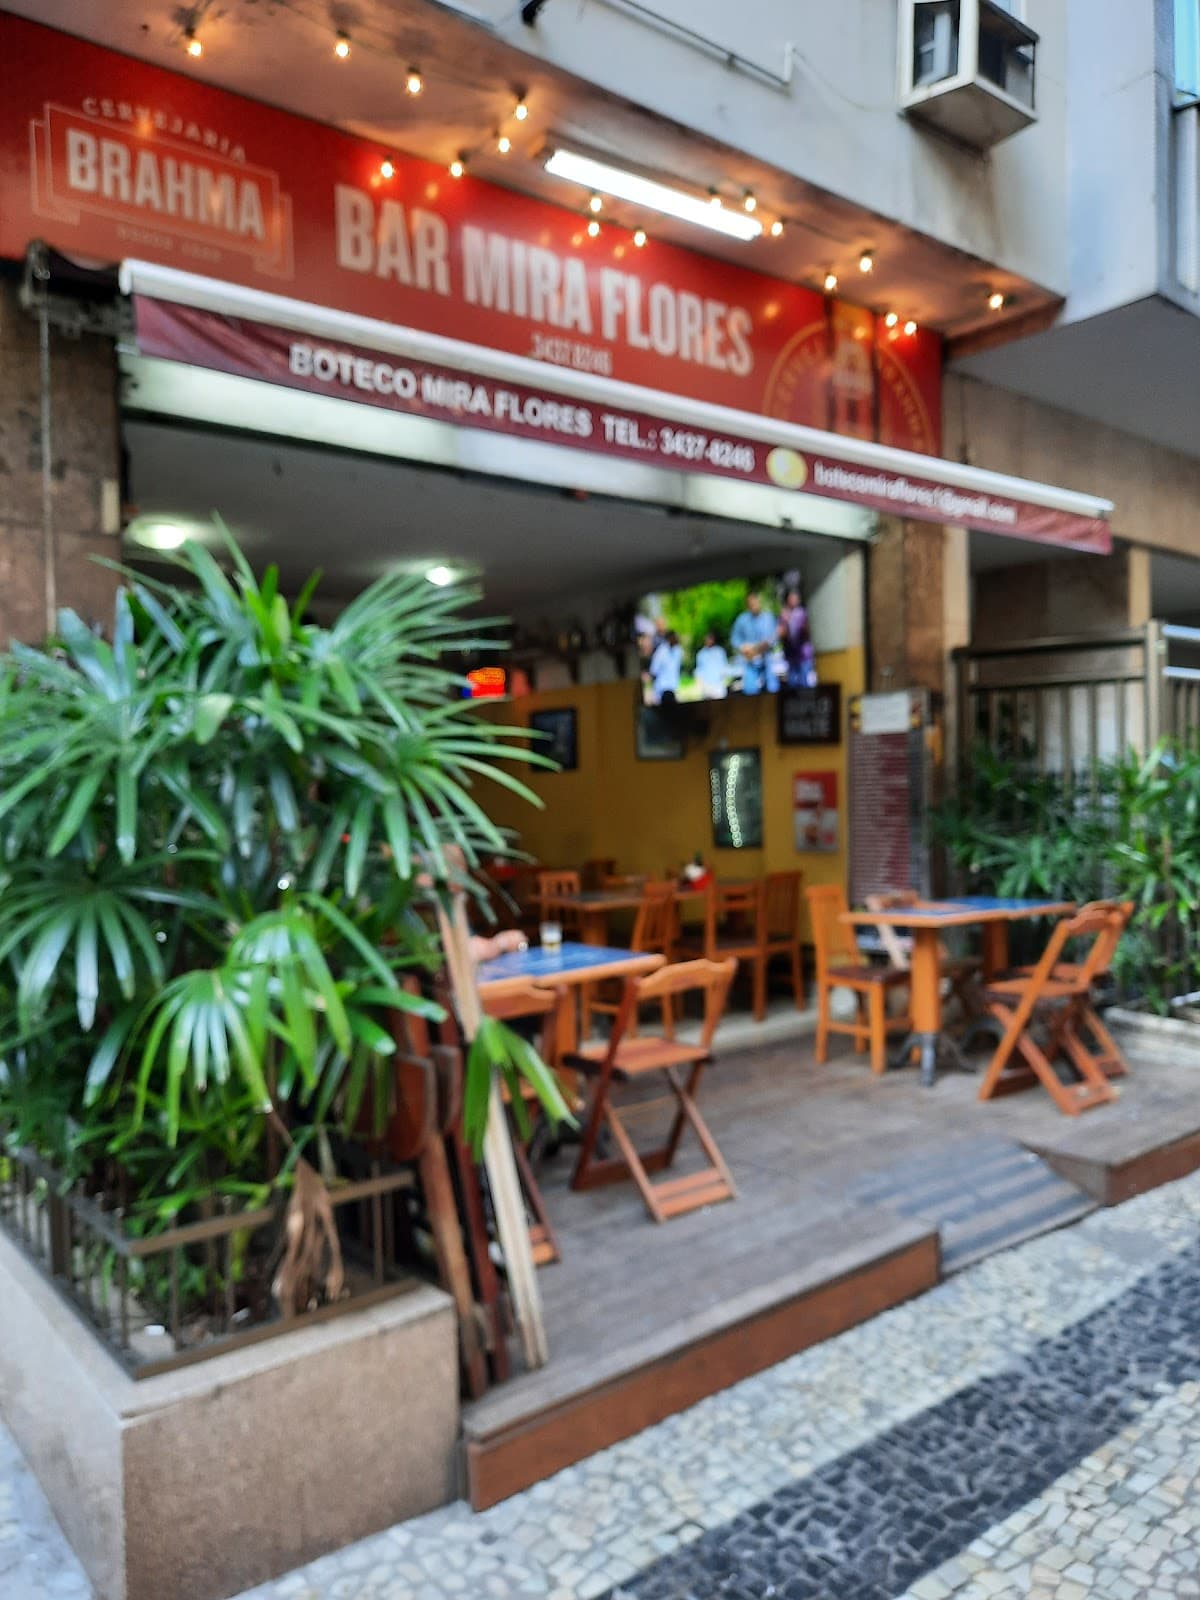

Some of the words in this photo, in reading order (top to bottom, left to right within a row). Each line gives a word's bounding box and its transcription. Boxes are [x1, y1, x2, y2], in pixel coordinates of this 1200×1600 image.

[82, 97, 247, 163] CERVEJARIA
[66, 128, 265, 240] BRAHMA
[334, 183, 451, 296] BAR
[461, 224, 592, 335] MIRA
[600, 266, 756, 377] FLORES
[289, 342, 417, 399] BOTECO
[421, 374, 491, 417] MIRA
[494, 391, 593, 438] FLORES
